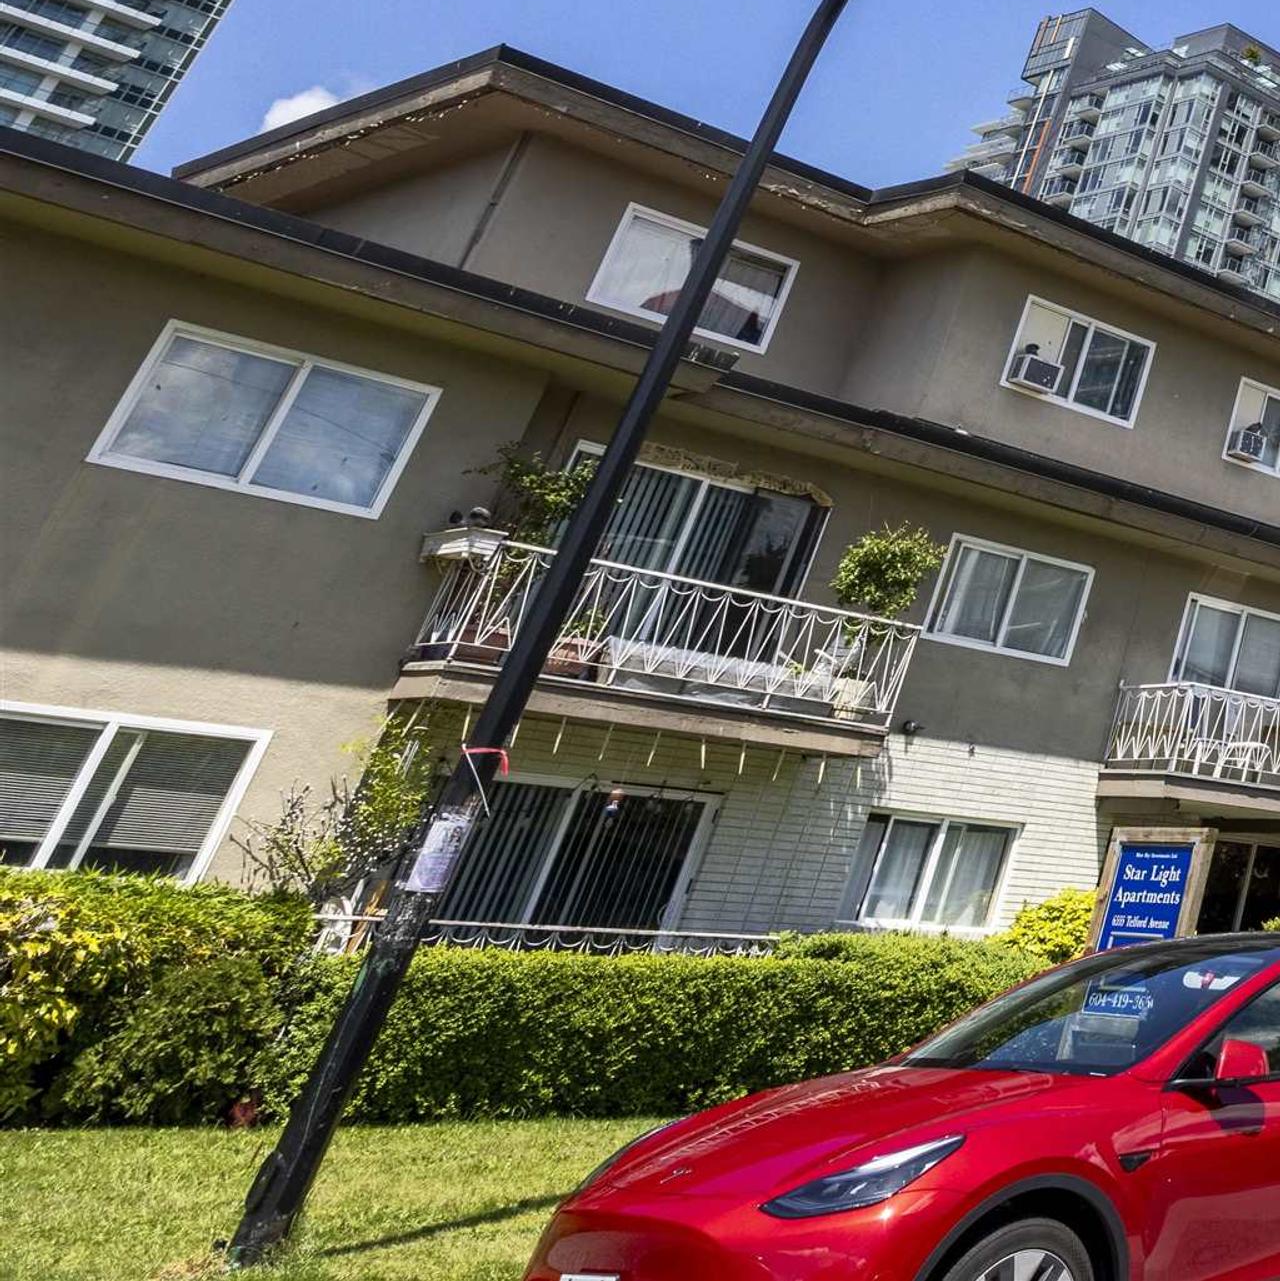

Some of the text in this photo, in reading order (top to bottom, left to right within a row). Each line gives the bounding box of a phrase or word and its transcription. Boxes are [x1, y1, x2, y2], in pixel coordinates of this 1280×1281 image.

[1123, 864, 1181, 888] Star Light
[1113, 886, 1181, 908] Apartments
[1126, 915, 1149, 928] Telford
[1147, 916, 1170, 929] Avenue
